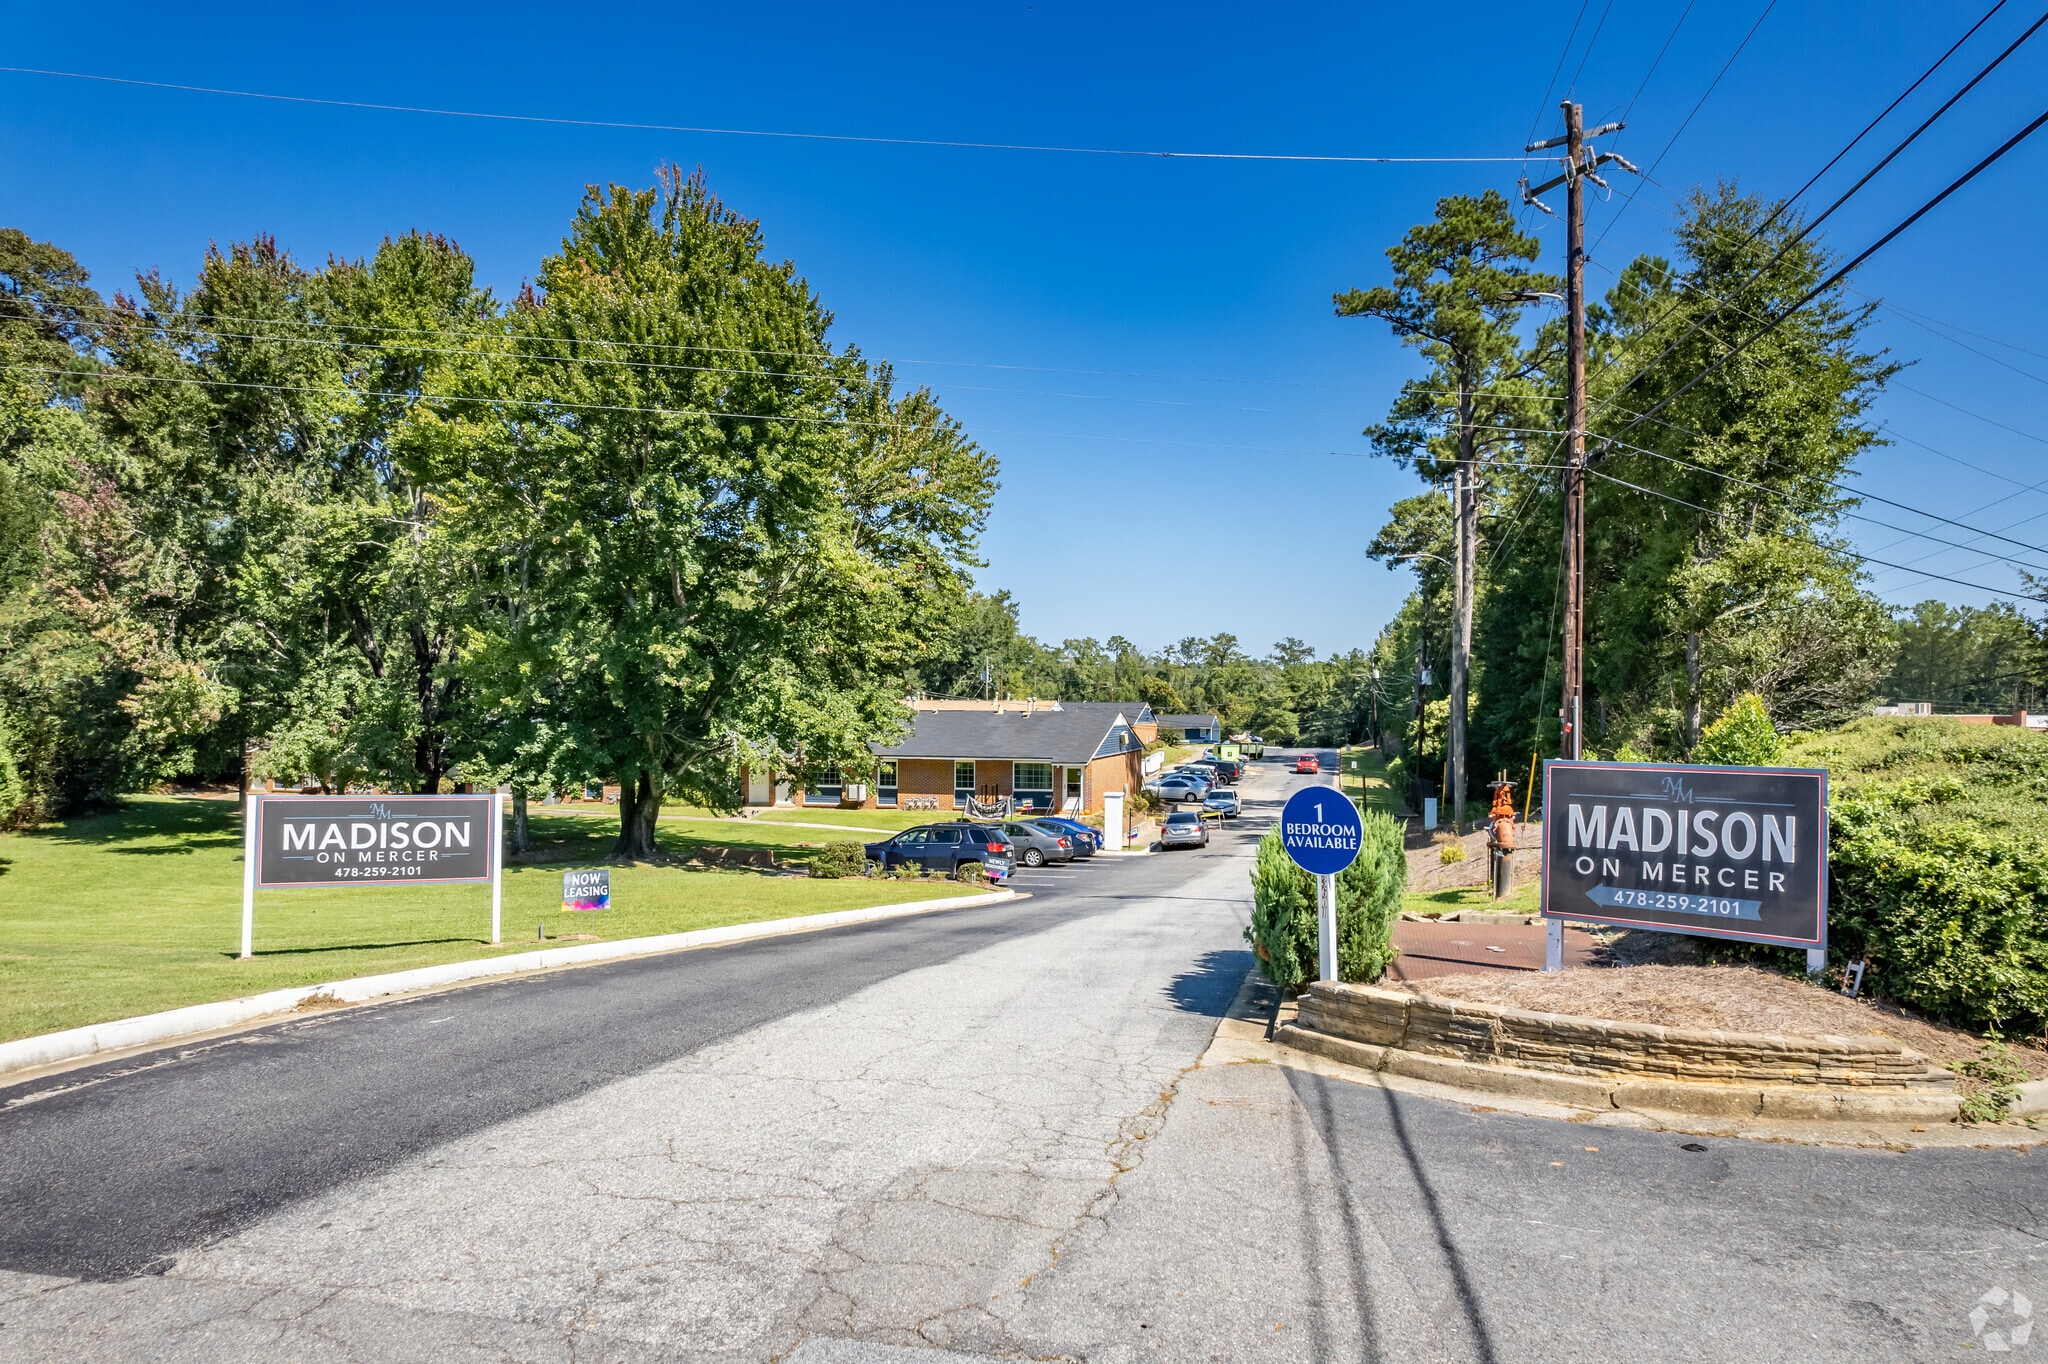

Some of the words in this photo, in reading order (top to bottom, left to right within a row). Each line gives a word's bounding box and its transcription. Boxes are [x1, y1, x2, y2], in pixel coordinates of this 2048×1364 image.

[1313, 803, 1323, 823] 1
[283, 821, 471, 851] MADISON
[1286, 823, 1356, 837] BEDROOM
[1567, 803, 1796, 864] MADISON
[1286, 836, 1357, 850] AVAILABLE
[316, 851, 346, 864] ON
[358, 850, 438, 862] MERCER
[334, 866, 422, 878] 478-259-2101
[571, 872, 601, 886] NOW
[1575, 855, 1620, 878] ON
[1642, 860, 1786, 893] MERCER
[564, 884, 608, 898] LEASING
[1613, 889, 1741, 917] 478-259-2101
